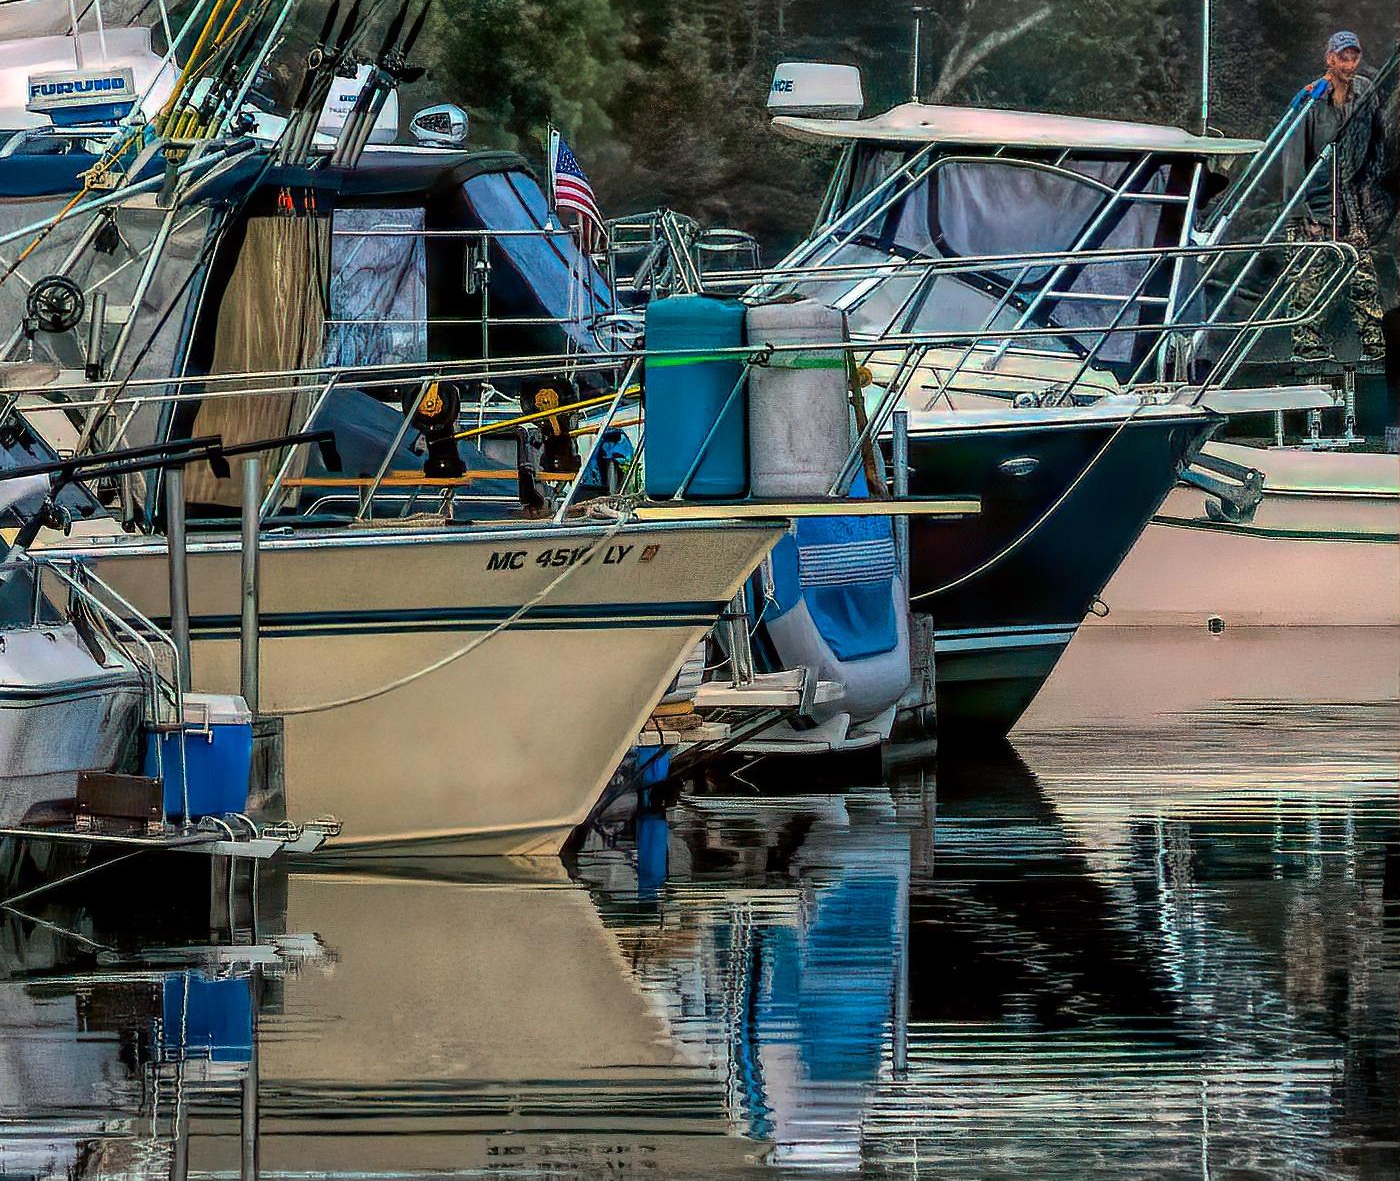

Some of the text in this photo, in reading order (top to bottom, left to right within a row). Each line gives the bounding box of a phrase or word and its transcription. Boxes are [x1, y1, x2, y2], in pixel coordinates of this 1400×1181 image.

[30, 78, 125, 97] FURUNO
[486, 551, 527, 570] MC
[603, 545, 634, 564] LY
